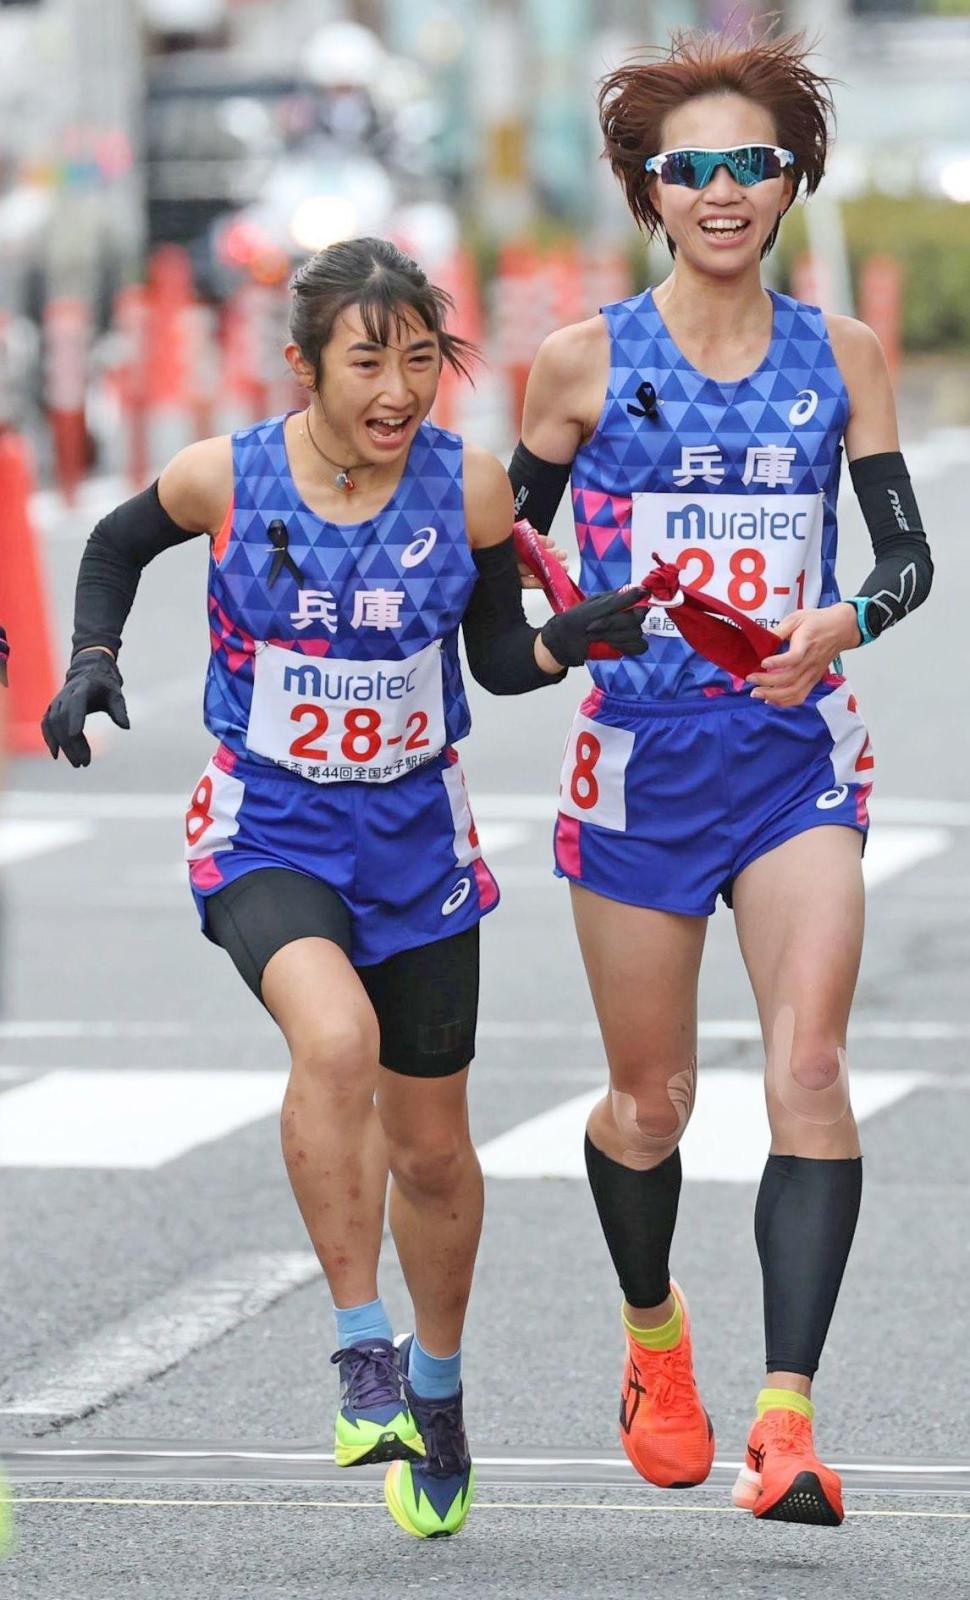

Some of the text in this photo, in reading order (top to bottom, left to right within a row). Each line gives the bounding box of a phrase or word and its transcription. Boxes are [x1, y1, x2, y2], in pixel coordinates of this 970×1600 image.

[672, 444, 797, 488] 兵庫
[675, 547, 807, 611] 28-1
[290, 588, 406, 633] 兵庫
[289, 703, 430, 763] 28-2
